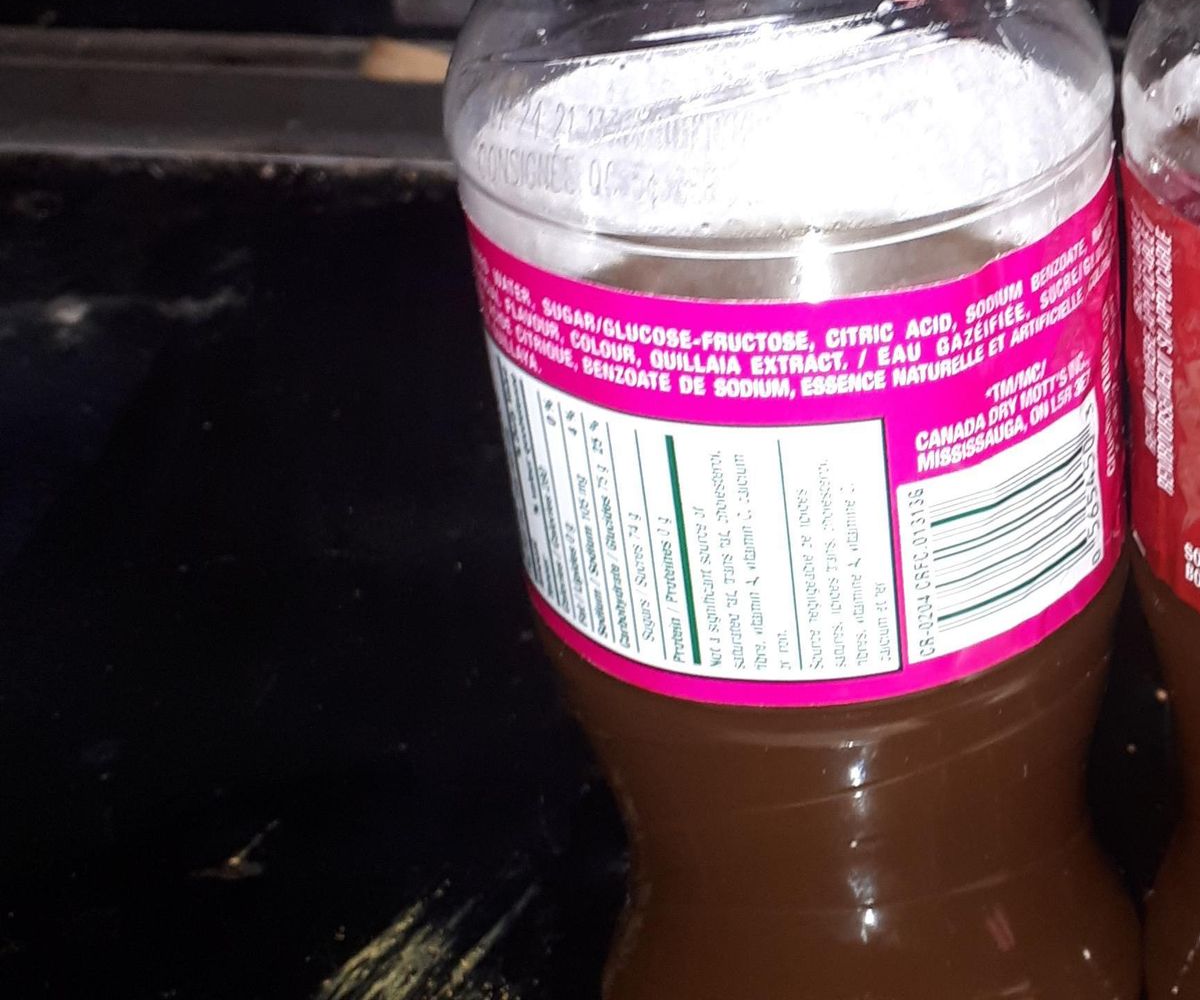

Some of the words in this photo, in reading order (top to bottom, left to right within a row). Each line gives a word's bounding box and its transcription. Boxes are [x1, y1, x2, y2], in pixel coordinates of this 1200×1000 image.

[581, 354, 672, 393] BENZOATE
[679, 375, 707, 397] DE
[713, 376, 797, 401] SODIUM,
[800, 370, 887, 397] ESSENCE
[891, 348, 985, 388] NATURELLE
[988, 339, 1006, 358] ET
[1009, 285, 1084, 348] ARTIFICIELLE
[825, 322, 894, 350] CITRIC
[904, 312, 958, 341] ACID,
[965, 280, 1024, 322] SODIUM
[569, 329, 643, 369] COLOUR,
[650, 348, 742, 376] QUILLAIA
[877, 341, 922, 368] EAU
[914, 417, 987, 454] CANADA
[987, 400, 1017, 432] DRY
[1019, 369, 1070, 414] MOTT'S
[916, 420, 1030, 473] MISSISSAUGA,
[1028, 409, 1050, 429] ON
[668, 617, 687, 663] Protein
